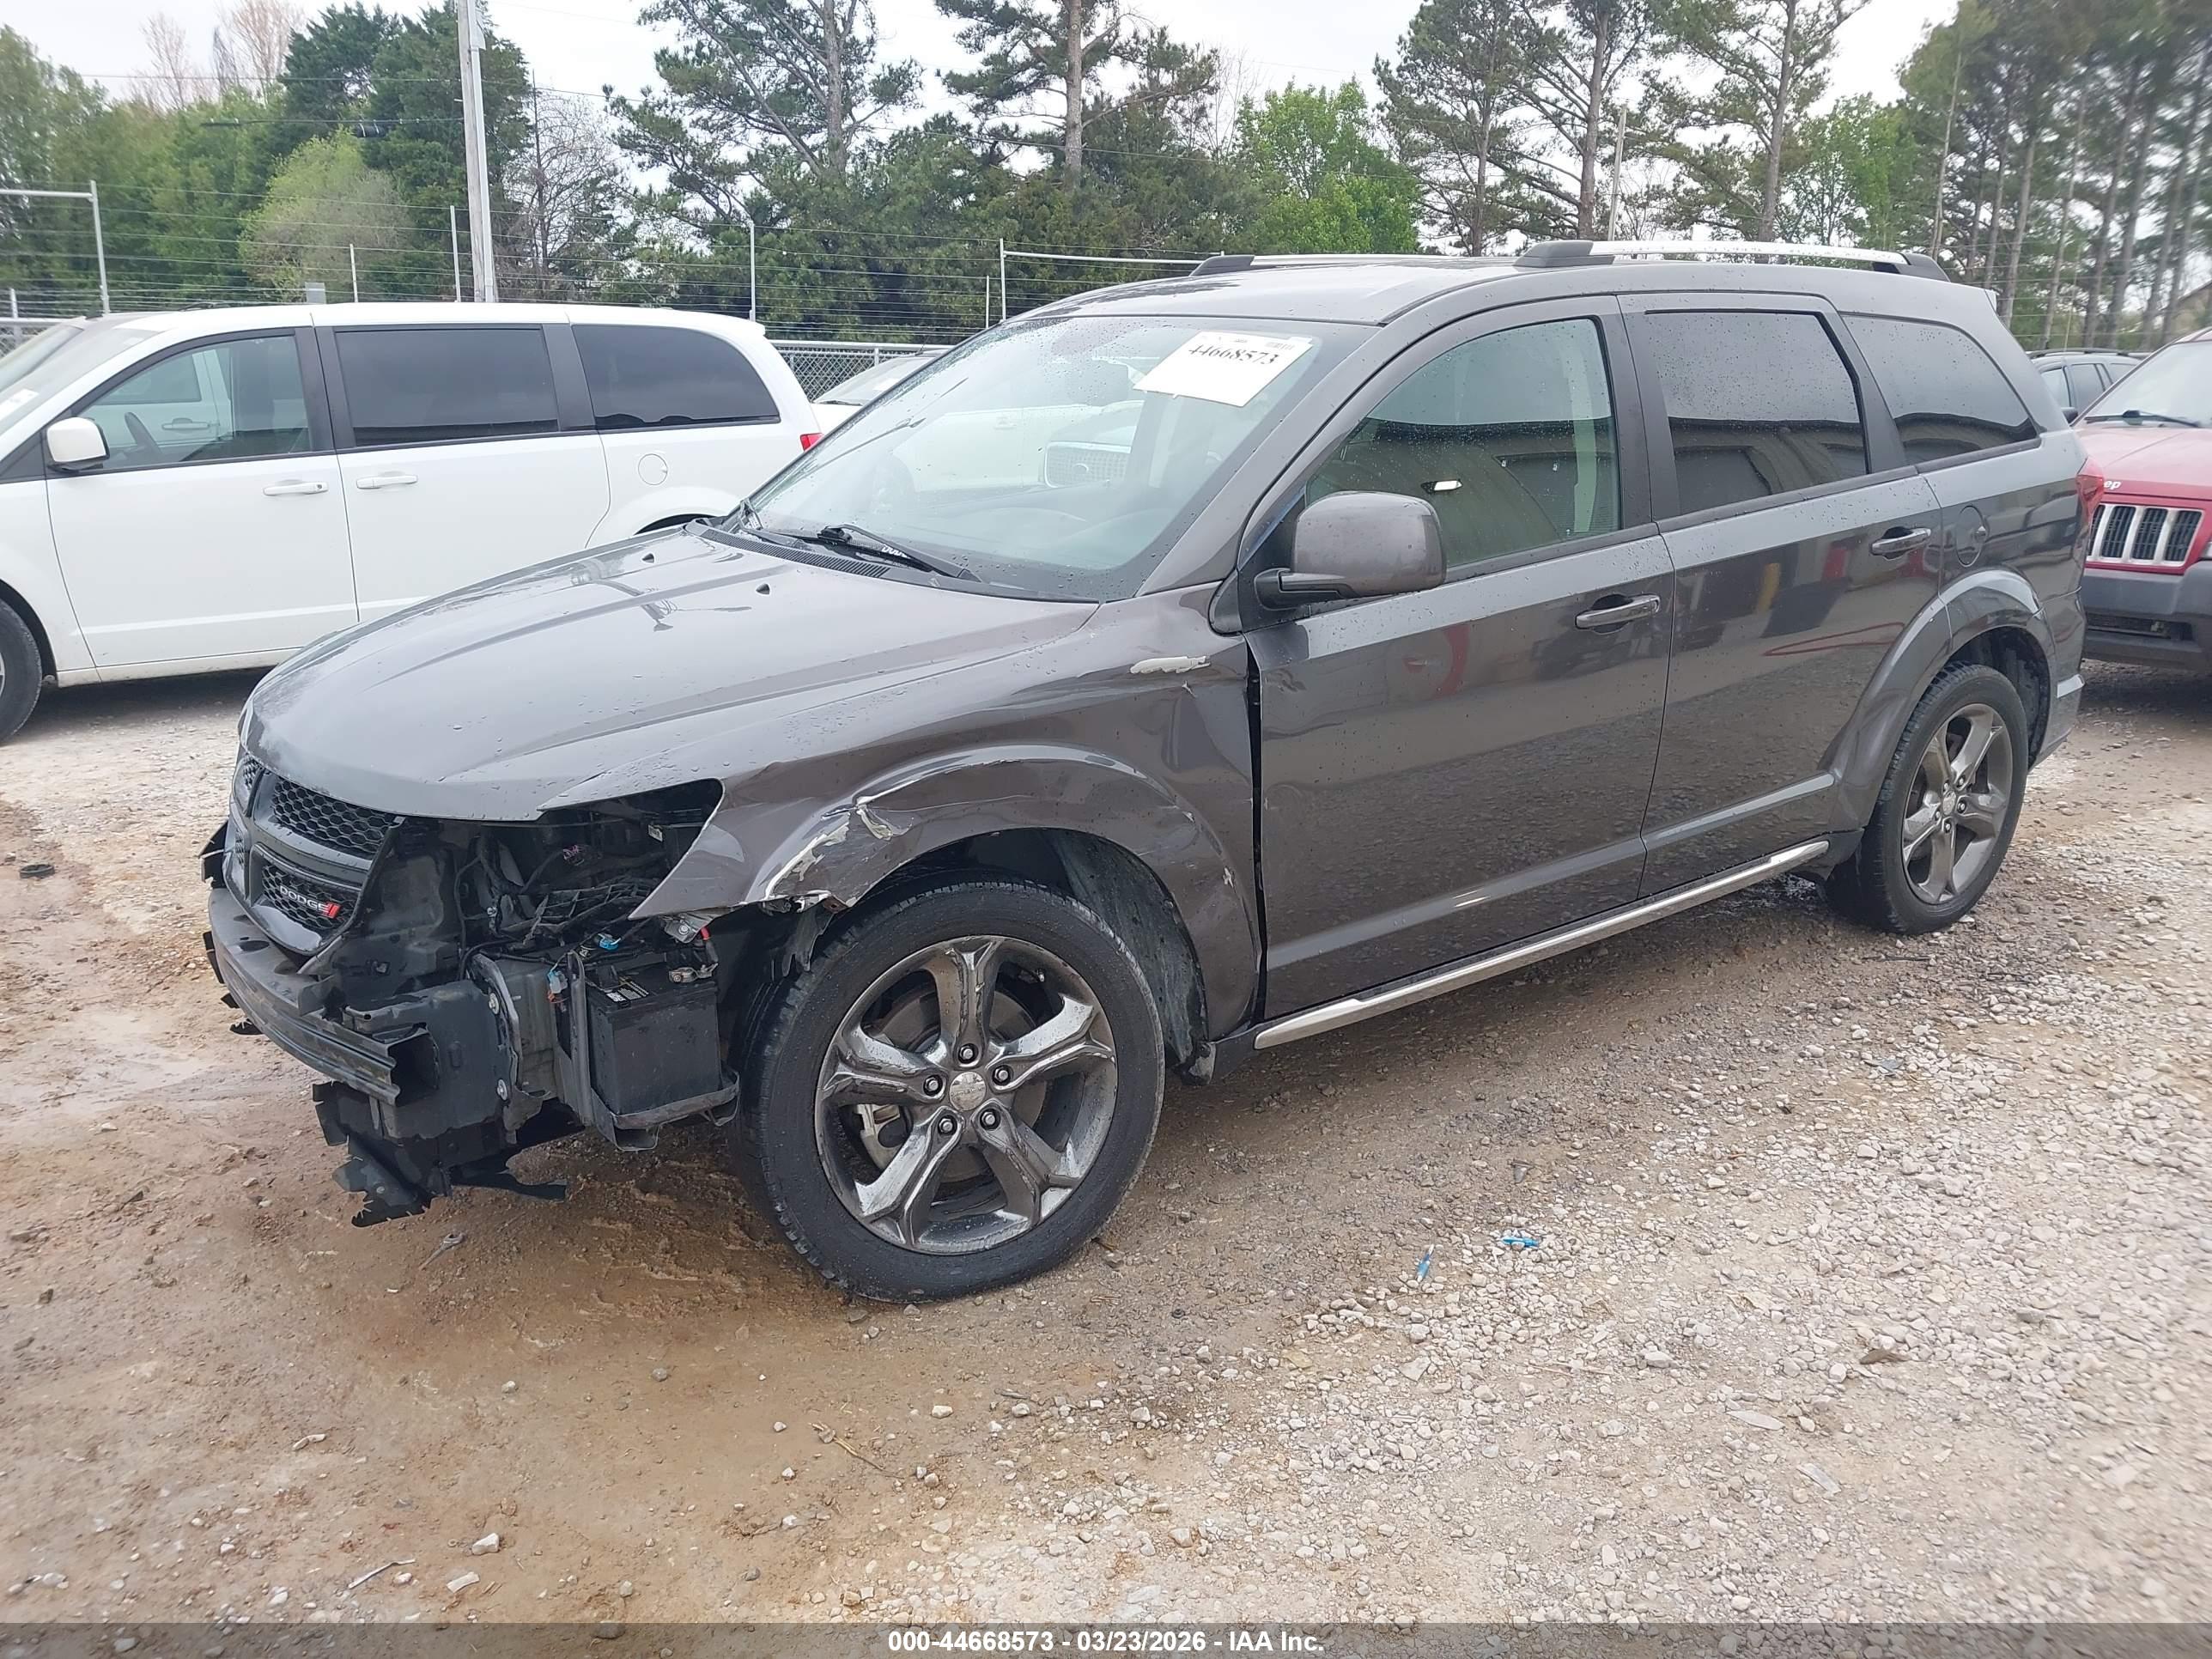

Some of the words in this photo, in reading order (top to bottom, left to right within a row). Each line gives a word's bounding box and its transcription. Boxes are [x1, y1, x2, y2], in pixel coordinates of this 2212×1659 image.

[1188, 344, 1279, 364] 44668573
[2104, 480, 2122, 490] ep
[280, 885, 330, 914] DODGE
